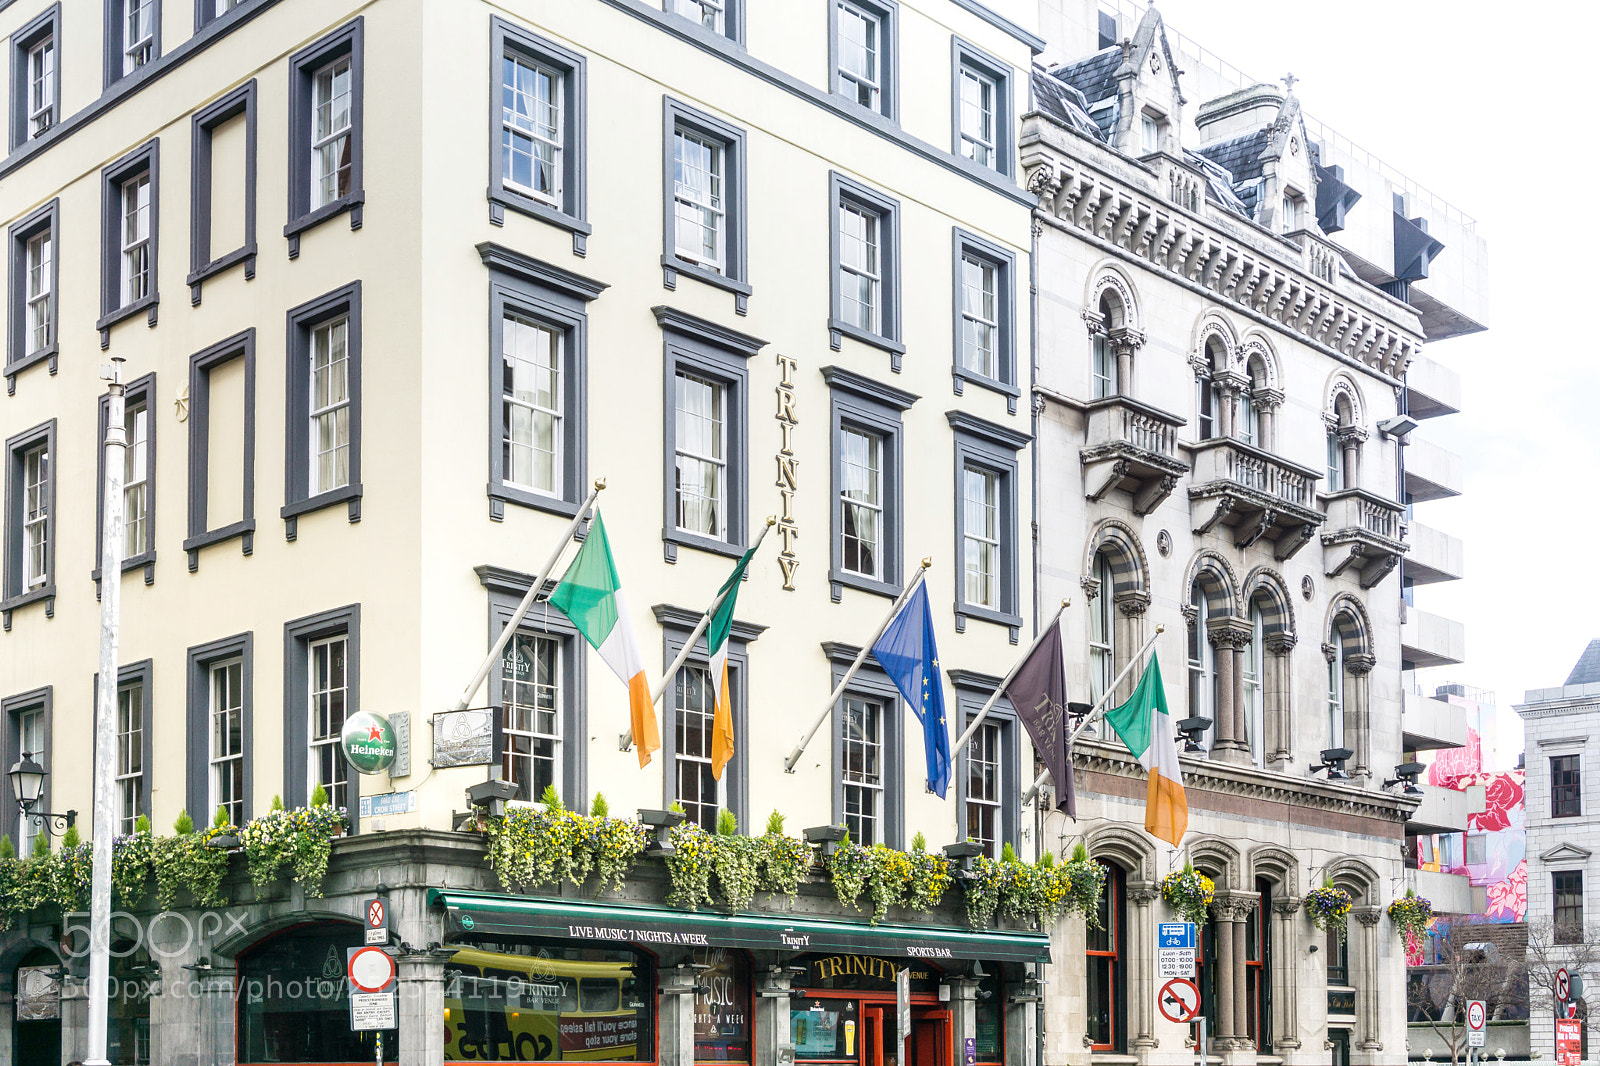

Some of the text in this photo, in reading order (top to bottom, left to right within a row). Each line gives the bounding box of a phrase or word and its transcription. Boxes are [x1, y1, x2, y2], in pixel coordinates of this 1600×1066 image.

[776, 353, 799, 591] TRINITY
[350, 744, 394, 757] Heineken
[569, 925, 709, 945] LIVE MUSIC 7 NIGHTS A WEEK
[906, 946, 952, 958] SPORTS BAR
[814, 954, 903, 983] TRINITY
[521, 980, 569, 997] TRINITY
[696, 976, 733, 1006] MUSIC
[725, 1014, 744, 1024] WEEK
